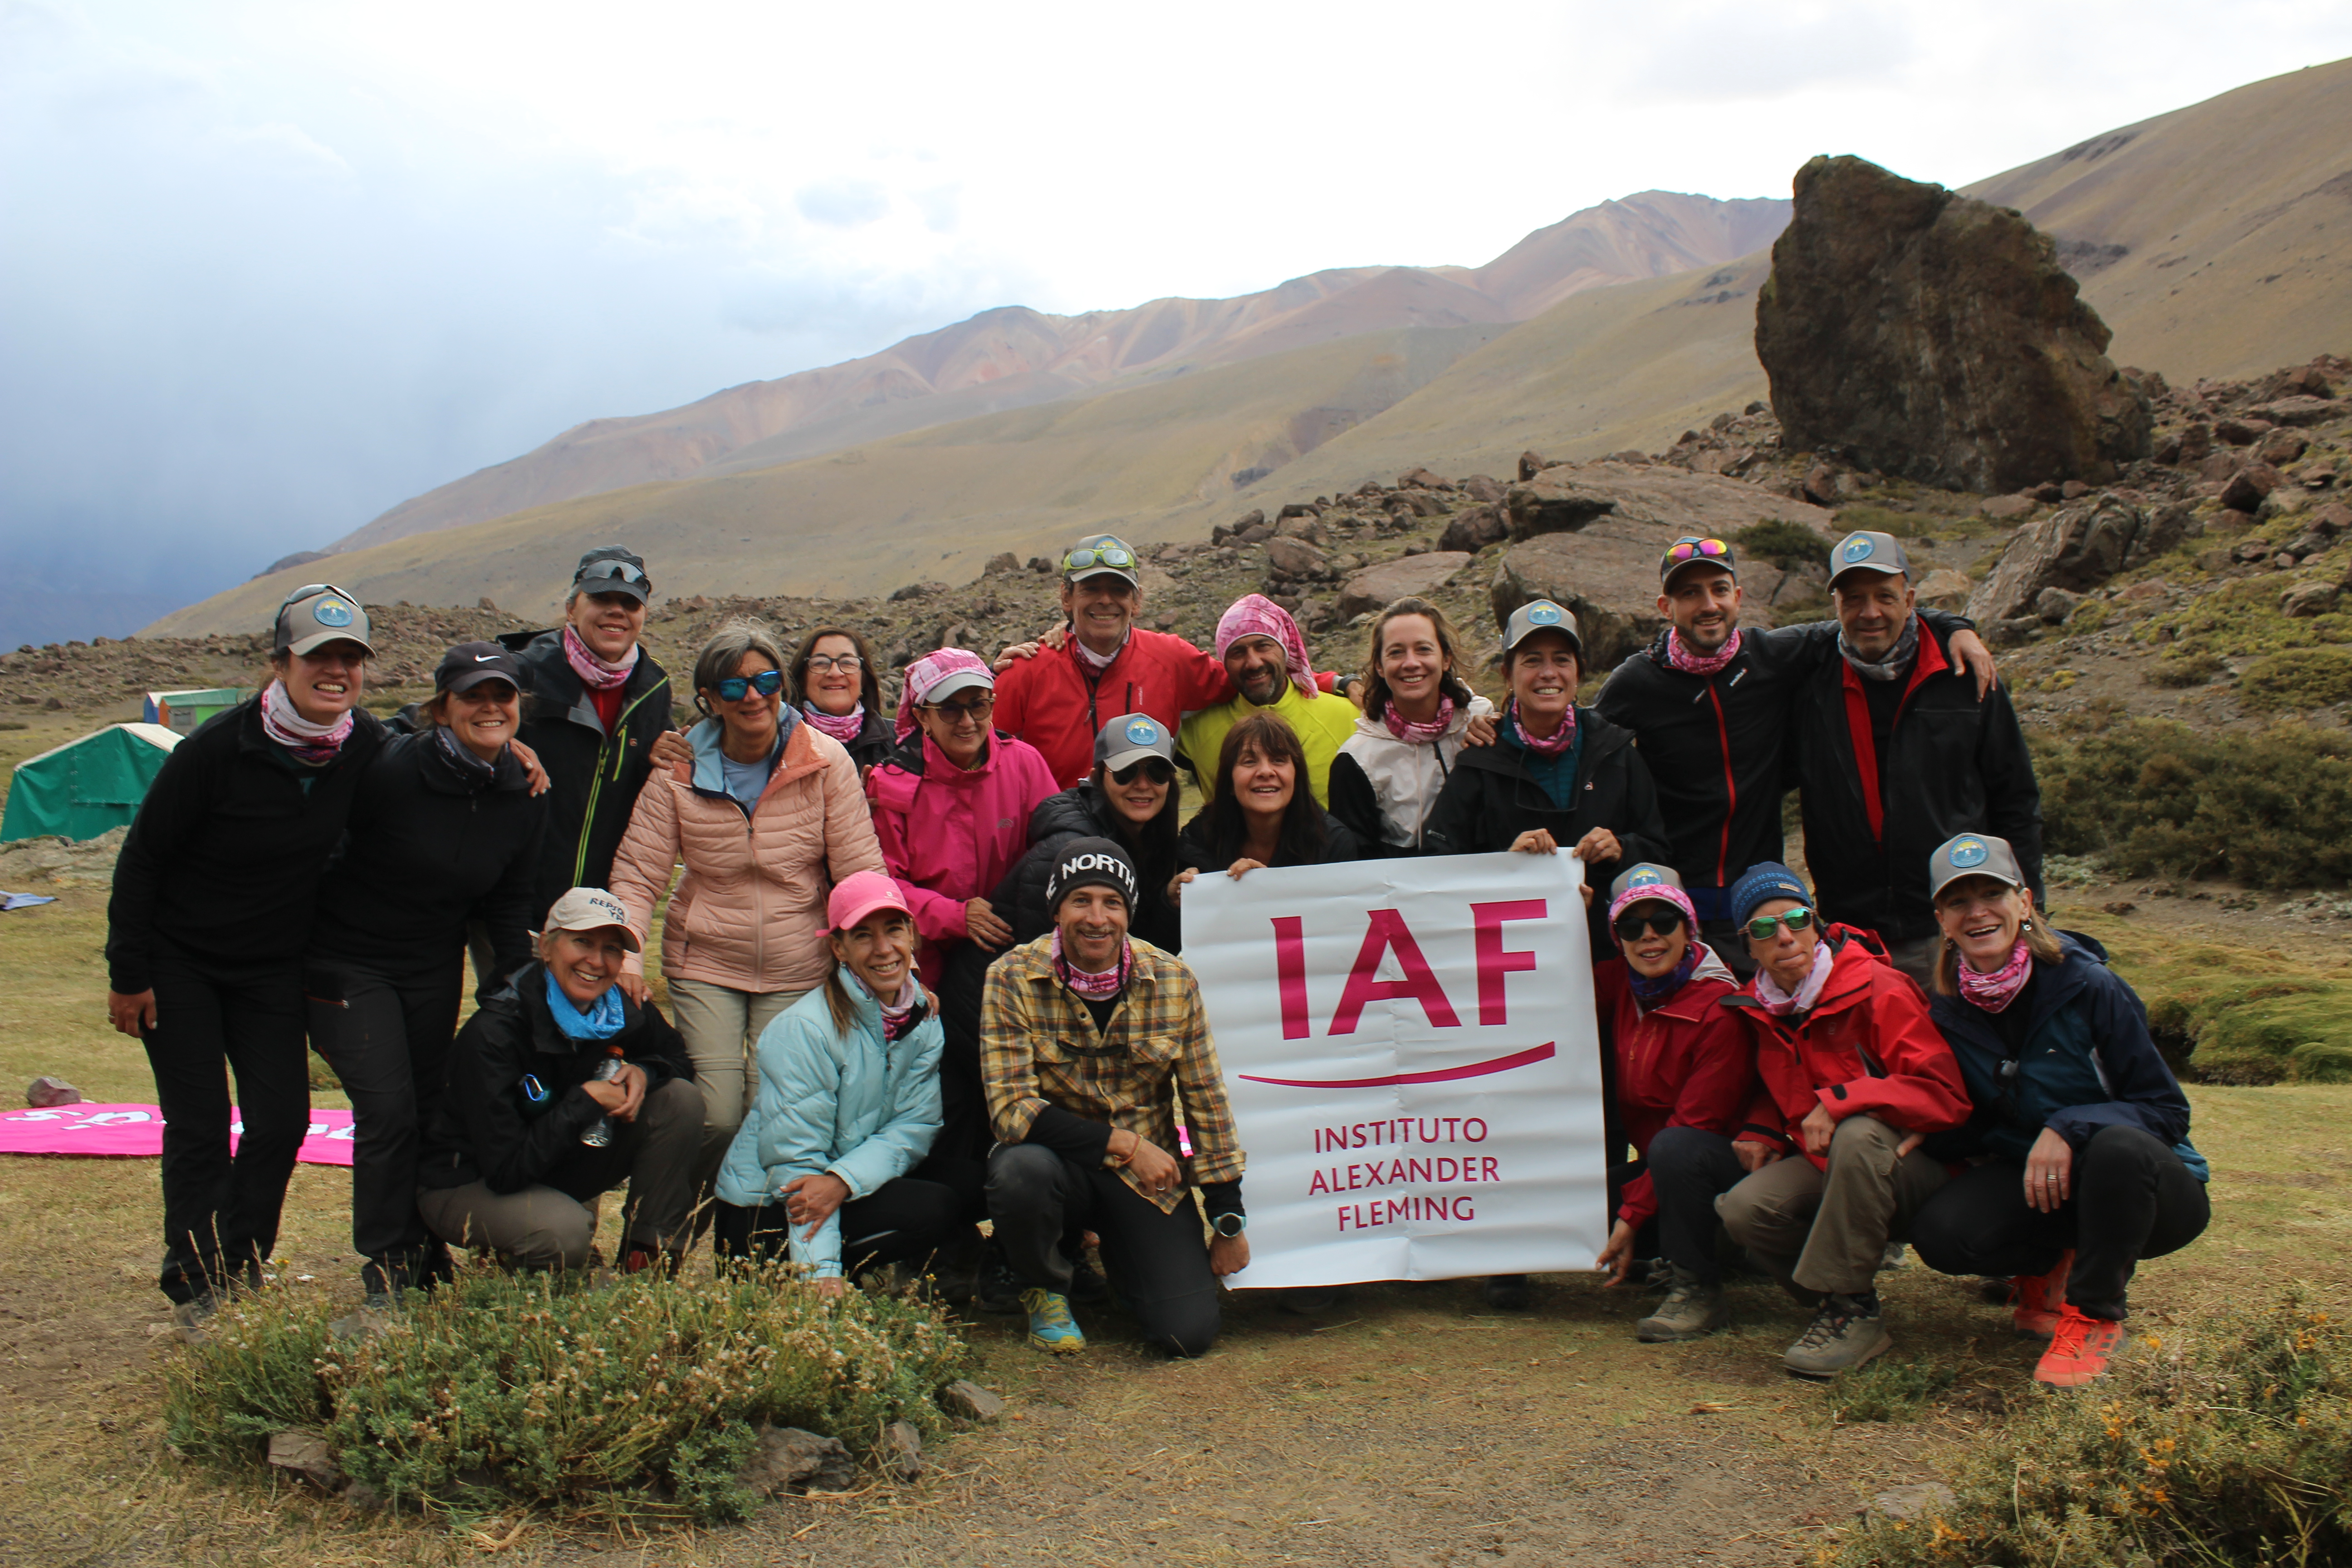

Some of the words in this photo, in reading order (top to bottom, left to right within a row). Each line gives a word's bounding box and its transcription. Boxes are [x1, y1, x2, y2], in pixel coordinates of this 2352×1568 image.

[1062, 853, 1135, 893] NORTH
[589, 898, 625, 917] REPSO
[1271, 899, 1548, 1040] IAF
[1316, 1118, 1488, 1153] INSTITUTO
[1309, 1157, 1500, 1196] ALEXANDER
[1339, 1196, 1475, 1232] FLEMING
